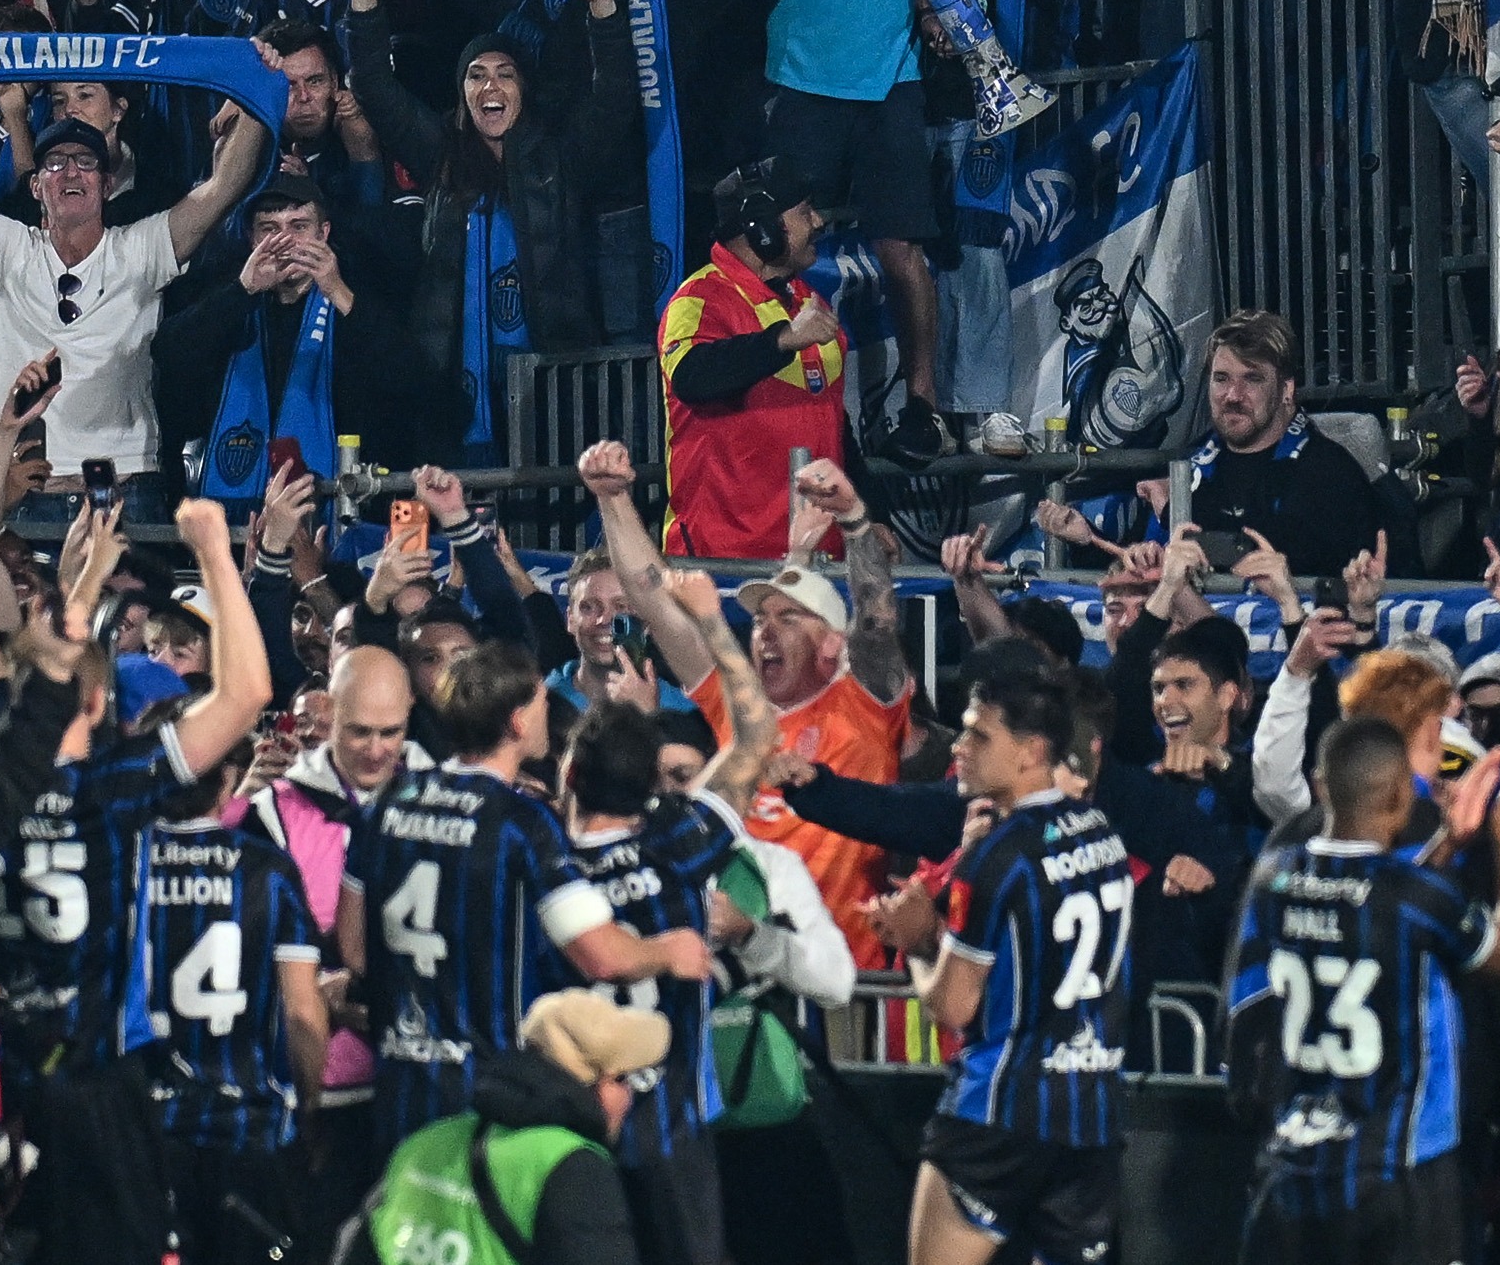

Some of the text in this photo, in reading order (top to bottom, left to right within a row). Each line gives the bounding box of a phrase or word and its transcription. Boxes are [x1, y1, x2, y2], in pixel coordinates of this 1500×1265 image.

[112, 35, 166, 69] FC
[150, 841, 242, 873] Liberty
[383, 860, 449, 979] 4
[1052, 874, 1135, 1010] 27
[1268, 947, 1384, 1079] 23
